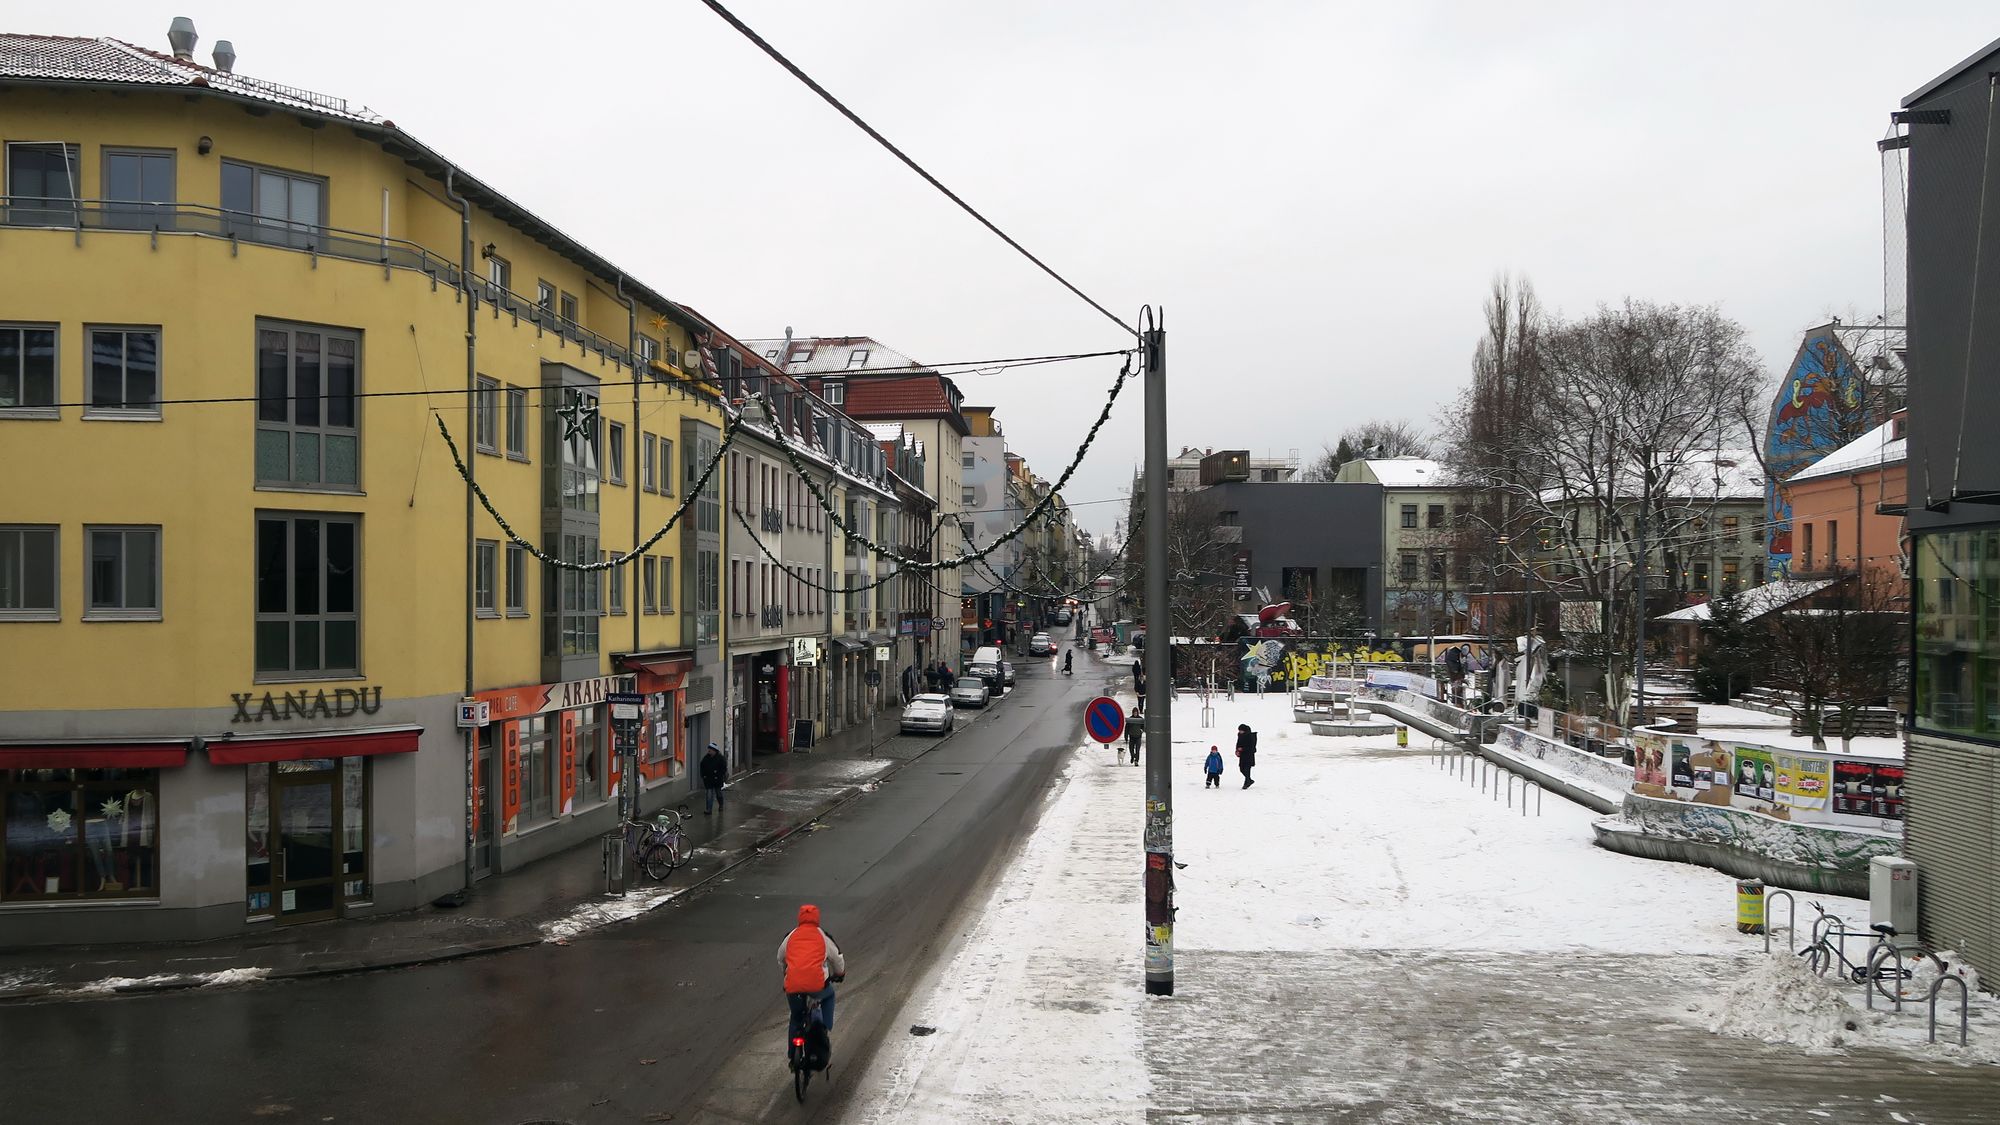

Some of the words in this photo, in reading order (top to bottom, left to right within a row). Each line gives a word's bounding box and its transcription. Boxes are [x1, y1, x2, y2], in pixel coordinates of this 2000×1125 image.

[231, 686, 382, 723] XANADU
[487, 696, 503, 715] PIEL
[562, 676, 619, 707] ARARAT
